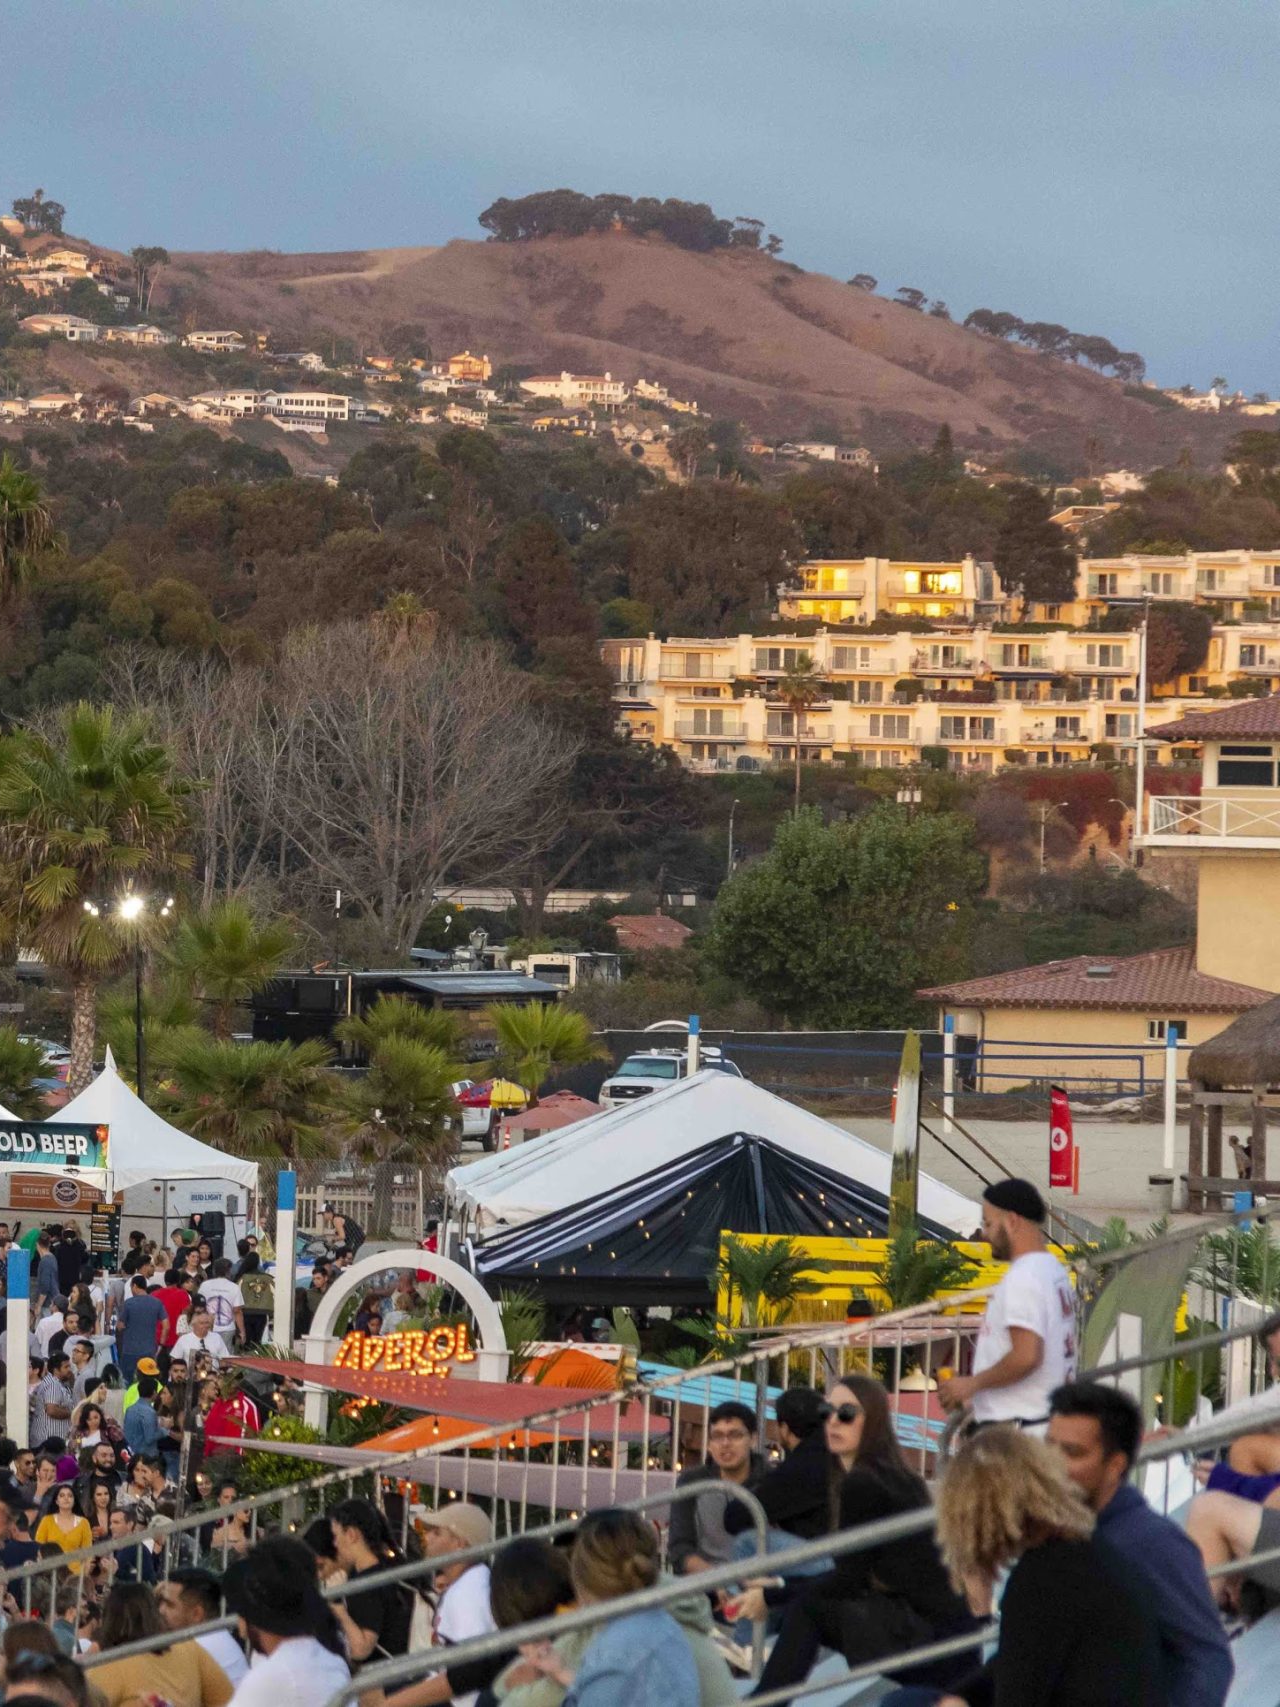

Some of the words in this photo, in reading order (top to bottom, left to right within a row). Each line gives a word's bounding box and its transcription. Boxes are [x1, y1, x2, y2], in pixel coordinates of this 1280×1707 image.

[40, 1133, 88, 1155] BEER
[1054, 1133, 1061, 1145] 4
[333, 1322, 477, 1376] APEROL
